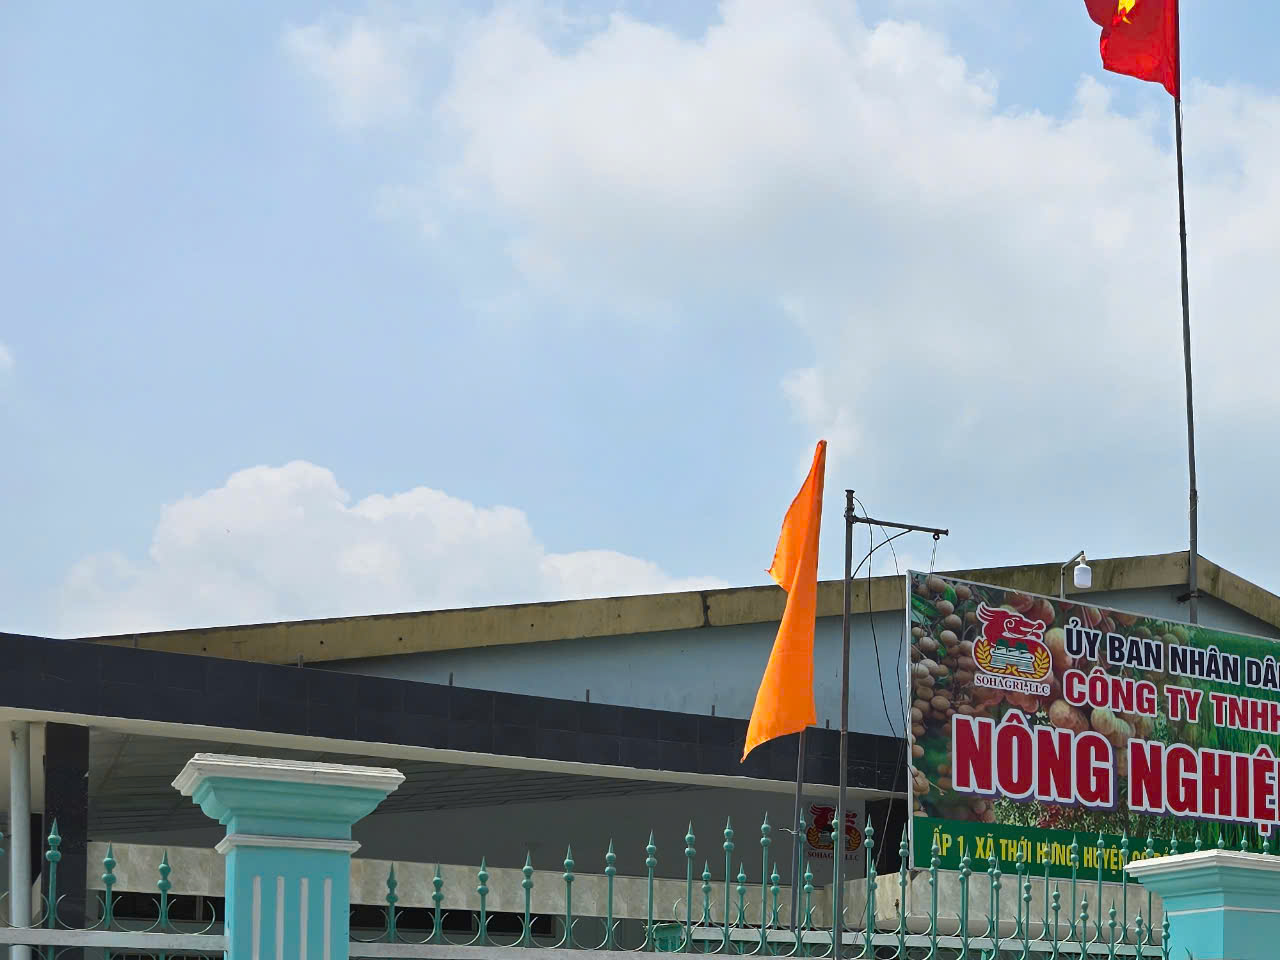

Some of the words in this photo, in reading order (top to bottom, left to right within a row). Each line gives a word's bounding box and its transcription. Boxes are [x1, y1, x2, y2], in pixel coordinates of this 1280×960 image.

[1065, 619, 1100, 659] ỦY
[1108, 634, 1162, 671] BAN
[1170, 646, 1239, 684] NHÂN
[1064, 669, 1158, 717] CÔNG
[1165, 686, 1203, 720] TY
[954, 711, 1112, 805] NÔNG
